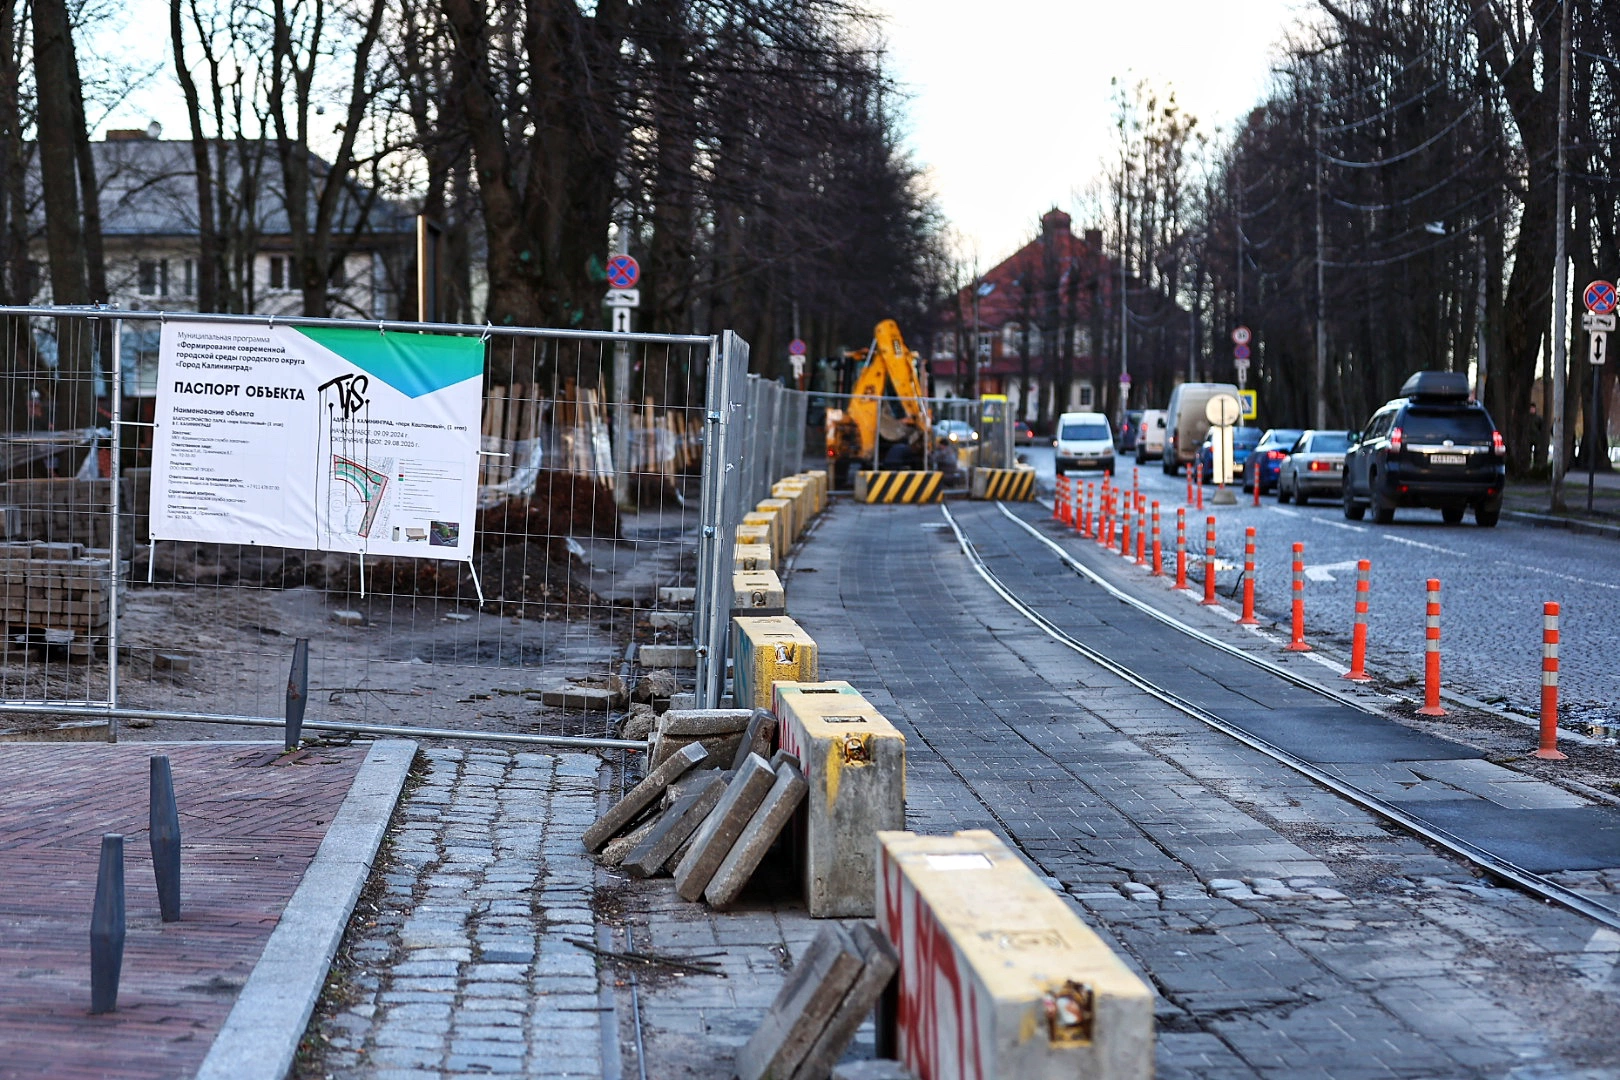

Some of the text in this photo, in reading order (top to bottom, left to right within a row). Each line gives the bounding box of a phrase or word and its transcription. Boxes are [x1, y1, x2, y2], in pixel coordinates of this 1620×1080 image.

[178, 332, 232, 341] Муниципальная
[177, 342, 286, 354] «Формирование современной
[176, 352, 214, 360] городской
[176, 360, 252, 372] «Город Калининград»
[174, 381, 306, 401] ПАСПОРТ ОБЪЕКТА
[173, 406, 254, 417] Наименование объекта
